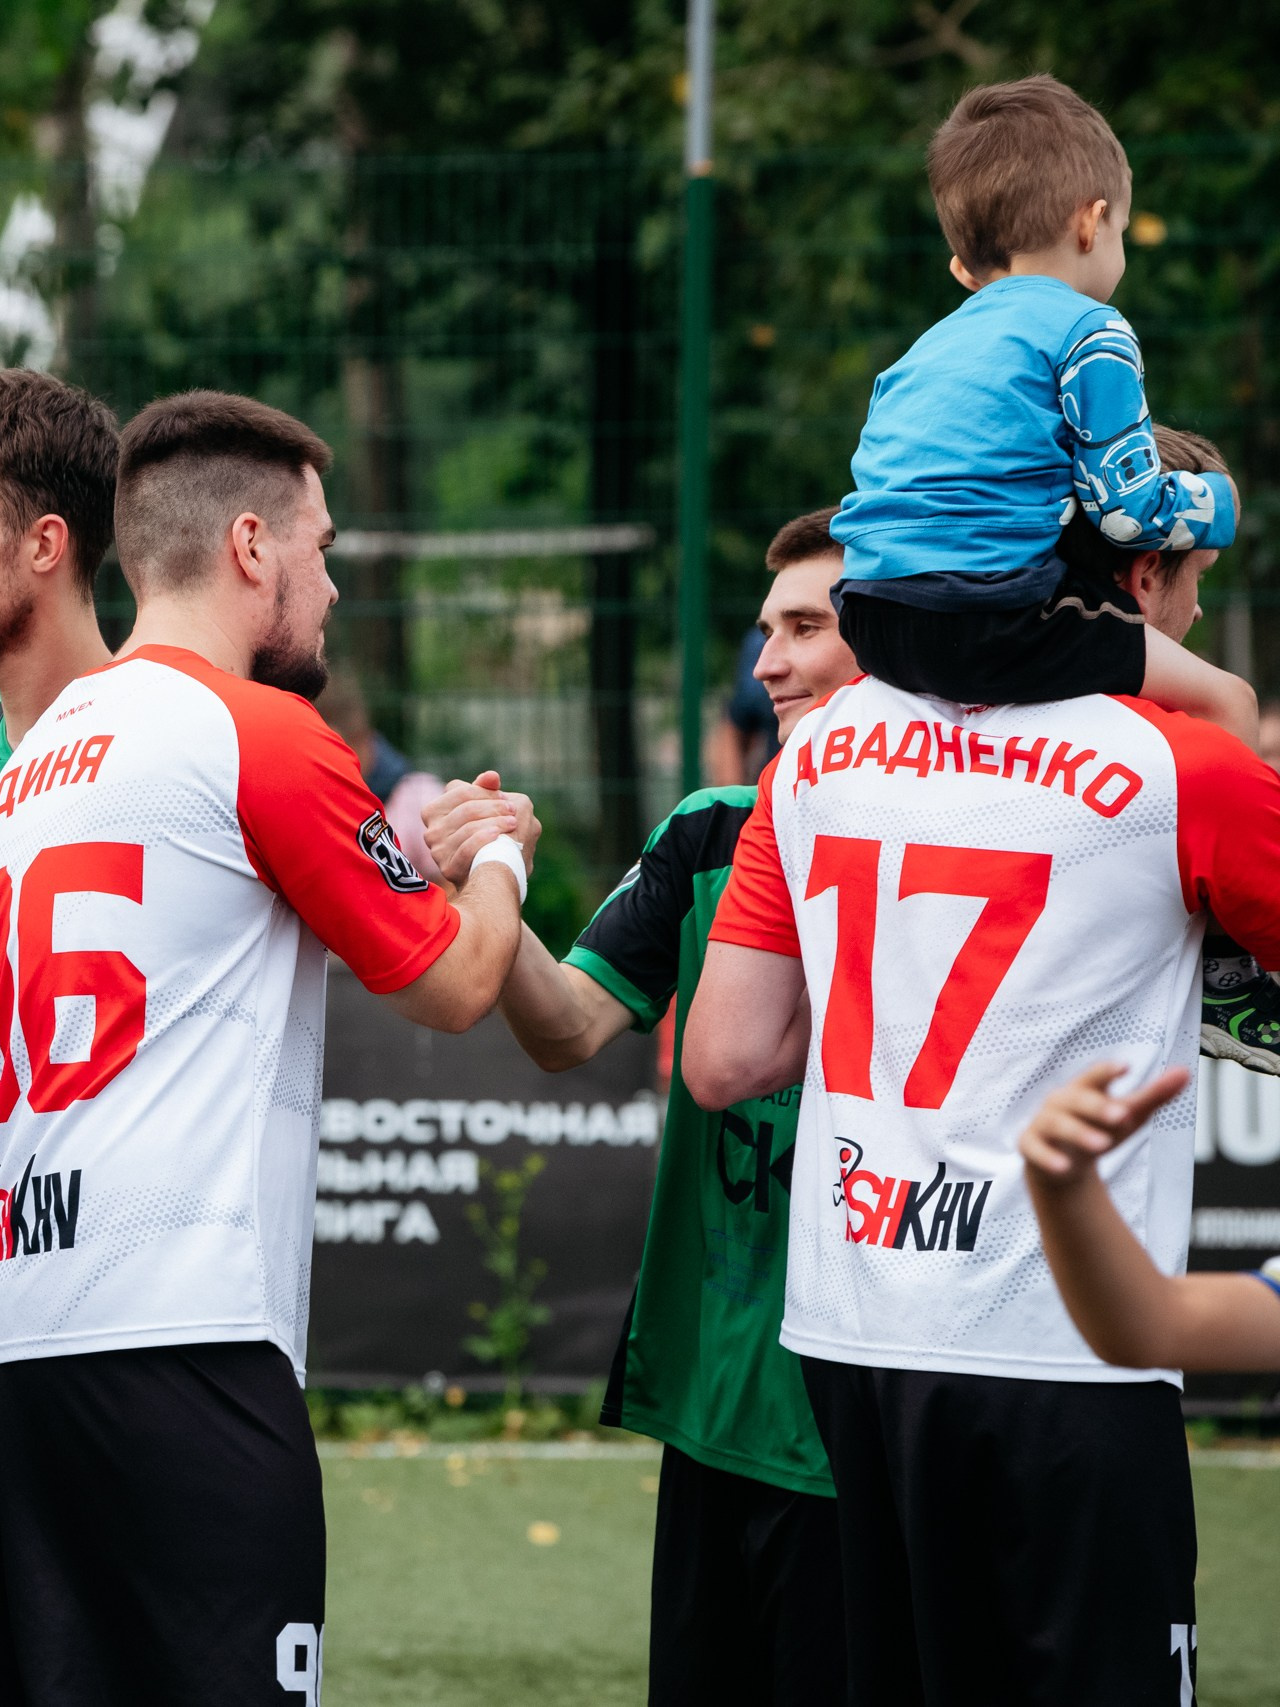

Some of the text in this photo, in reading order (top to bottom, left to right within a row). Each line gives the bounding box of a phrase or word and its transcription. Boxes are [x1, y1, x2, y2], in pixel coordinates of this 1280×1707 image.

[804, 834, 1053, 1110] 17
[315, 1200, 441, 1244] ИГА
[276, 1622, 325, 1707] 9
[1170, 1623, 1197, 1707] 1
